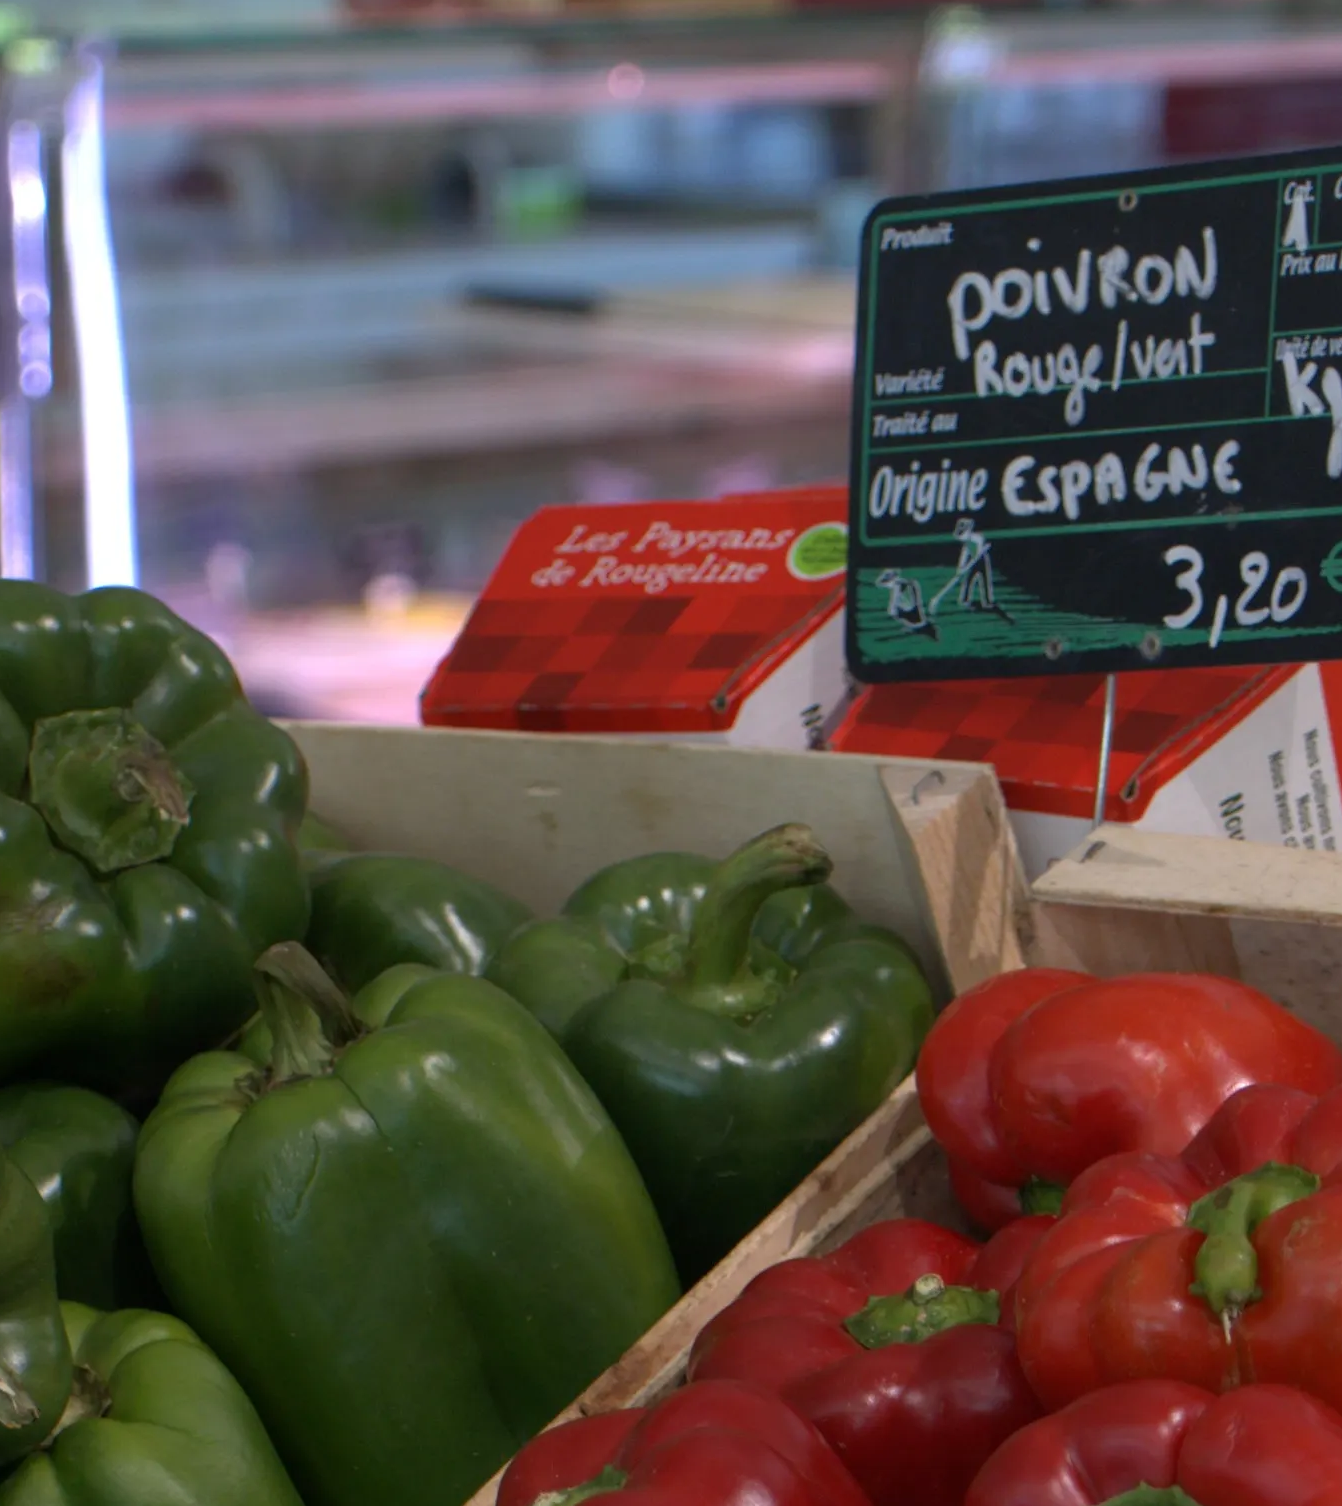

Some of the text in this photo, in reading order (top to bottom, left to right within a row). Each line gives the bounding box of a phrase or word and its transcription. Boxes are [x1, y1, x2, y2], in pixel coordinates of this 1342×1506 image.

[880, 221, 955, 251] Produit
[1280, 252, 1313, 277] Prix
[1315, 252, 1337, 273] au
[1311, 335, 1328, 357] de
[876, 367, 946, 396] Variété
[873, 411, 959, 437] Traité au
[869, 458, 989, 522] Origine
[555, 525, 628, 554] Les
[631, 521, 796, 558] Paysans
[531, 554, 768, 594] de Rougeline
[1163, 545, 1308, 648] 3,20
